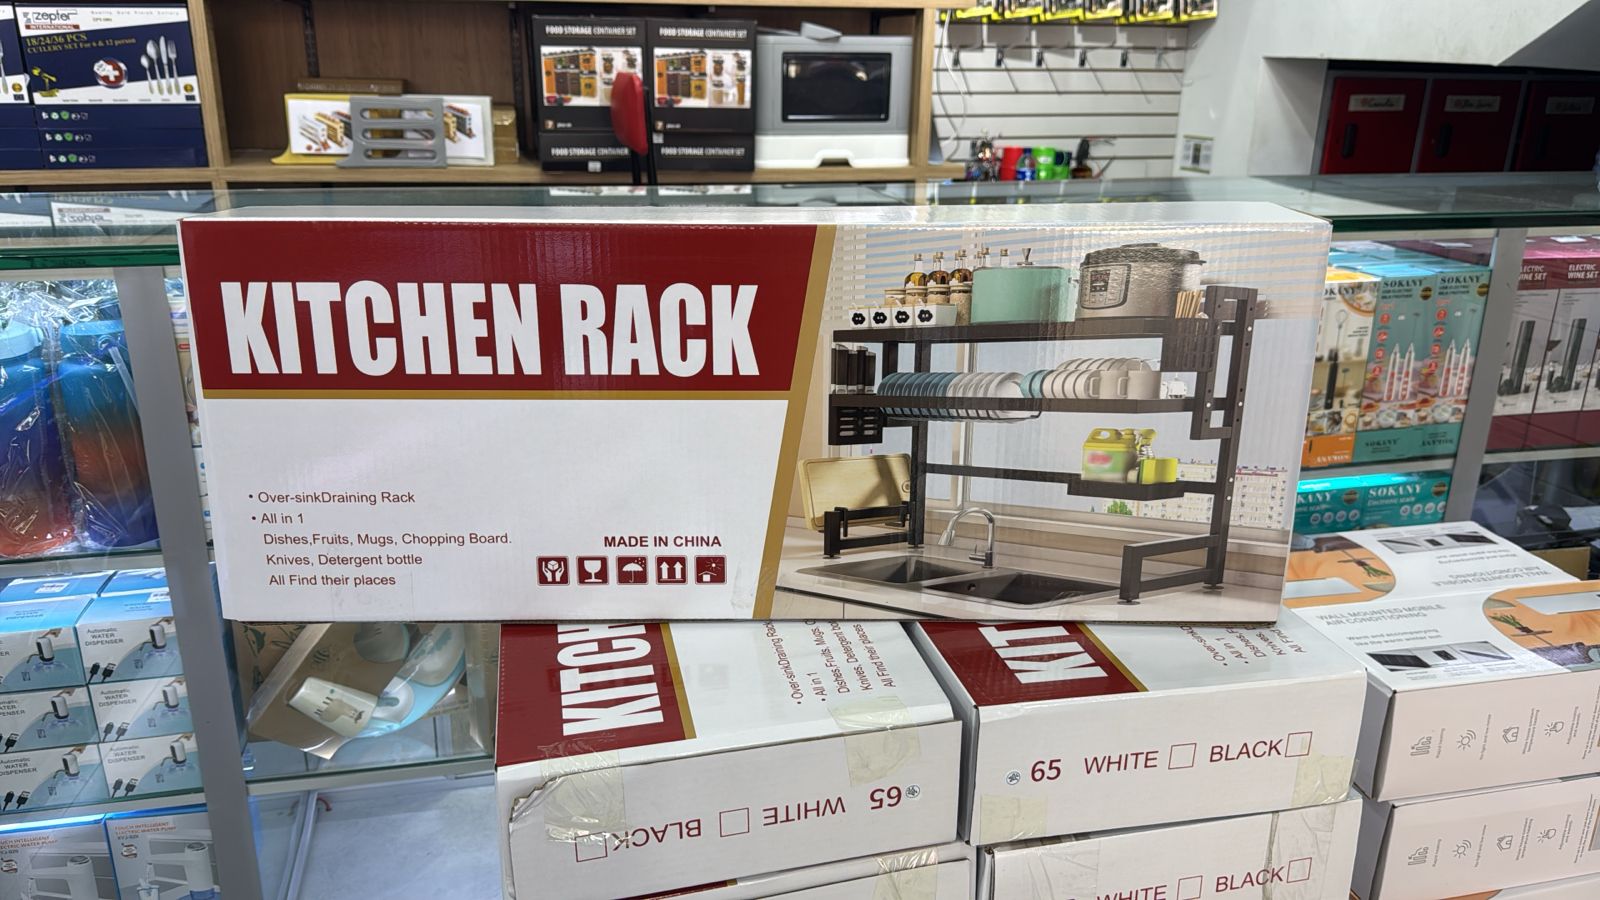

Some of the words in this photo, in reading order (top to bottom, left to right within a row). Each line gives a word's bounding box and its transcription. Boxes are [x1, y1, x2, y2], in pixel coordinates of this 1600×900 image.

[32, 9, 77, 24] zepter
[545, 25, 563, 34] FOOD
[564, 26, 592, 35] STORAGE
[593, 27, 625, 35] CONTAINER
[626, 27, 637, 36] SET
[659, 27, 676, 36] FOOD
[677, 28, 704, 37] STORAGE
[705, 29, 736, 38] CONTAINER
[737, 30, 747, 38] SET
[26, 35, 64, 46] 18/24/36
[66, 33, 88, 43] PCS
[27, 45, 63, 54] CUTLERY
[551, 147, 568, 156] FOOD
[569, 147, 596, 156] STORAGE
[661, 147, 677, 156] FOOD
[678, 147, 704, 156] STORAGE
[704, 147, 735, 156] CONTAINER
[735, 148, 745, 156] SET
[1441, 274, 1481, 284] SOKANY
[1534, 272, 1547, 280] SET
[1568, 271, 1585, 279] WINE
[1585, 271, 1599, 279] SET
[1383, 279, 1424, 289] SOKANY
[220, 280, 542, 378] KITCHEN
[560, 281, 760, 379] RACK
[1368, 483, 1422, 498] SOKANY
[257, 491, 377, 506] Over-sinkDraining
[381, 491, 416, 503] Rack
[261, 513, 278, 524] All
[281, 513, 293, 524] in
[297, 513, 304, 524] 1
[263, 533, 354, 547] Dishes,Fruits,
[357, 533, 398, 547] Mugs,
[401, 532, 465, 547] Chopping
[469, 532, 513, 544] Board.
[604, 536, 649, 548] MADE
[653, 536, 669, 547] IN
[673, 535, 722, 547] CHINA
[266, 554, 314, 567] Knives,
[318, 554, 384, 568] Detergent
[386, 554, 423, 565] bottle
[269, 575, 286, 586] All
[289, 574, 318, 586] Find
[321, 574, 350, 586] their
[353, 574, 397, 588] places
[1316, 611, 1349, 621] WALL
[1350, 607, 1404, 618] MOUNTED
[1403, 603, 1448, 613] MOBILE
[1325, 618, 1346, 627] AIR
[1347, 612, 1428, 624] CONDITIONING
[853, 623, 874, 645] places
[85, 638, 124, 647] DISPENSER
[834, 631, 859, 664] Detergent
[865, 645, 880, 661] their
[772, 637, 804, 700] Over-sinkDraining
[873, 661, 890, 677] Find
[811, 677, 820, 686] in
[882, 677, 896, 688] All
[100, 688, 131, 696] Automatic
[815, 686, 828, 697] All
[99, 699, 137, 708] DISPENSER
[109, 744, 140, 752] Automatic
[0, 756, 31, 764] Automatic
[4, 762, 29, 770] WATER
[107, 755, 146, 764] DISPENSER
[1031, 758, 1062, 783] 65
[1084, 750, 1160, 775] WHITE
[1209, 738, 1284, 763] BLACK
[869, 785, 902, 810] 65
[763, 796, 846, 827] WHITE
[610, 818, 702, 852] BLACK
[1215, 865, 1286, 893] BLACK
